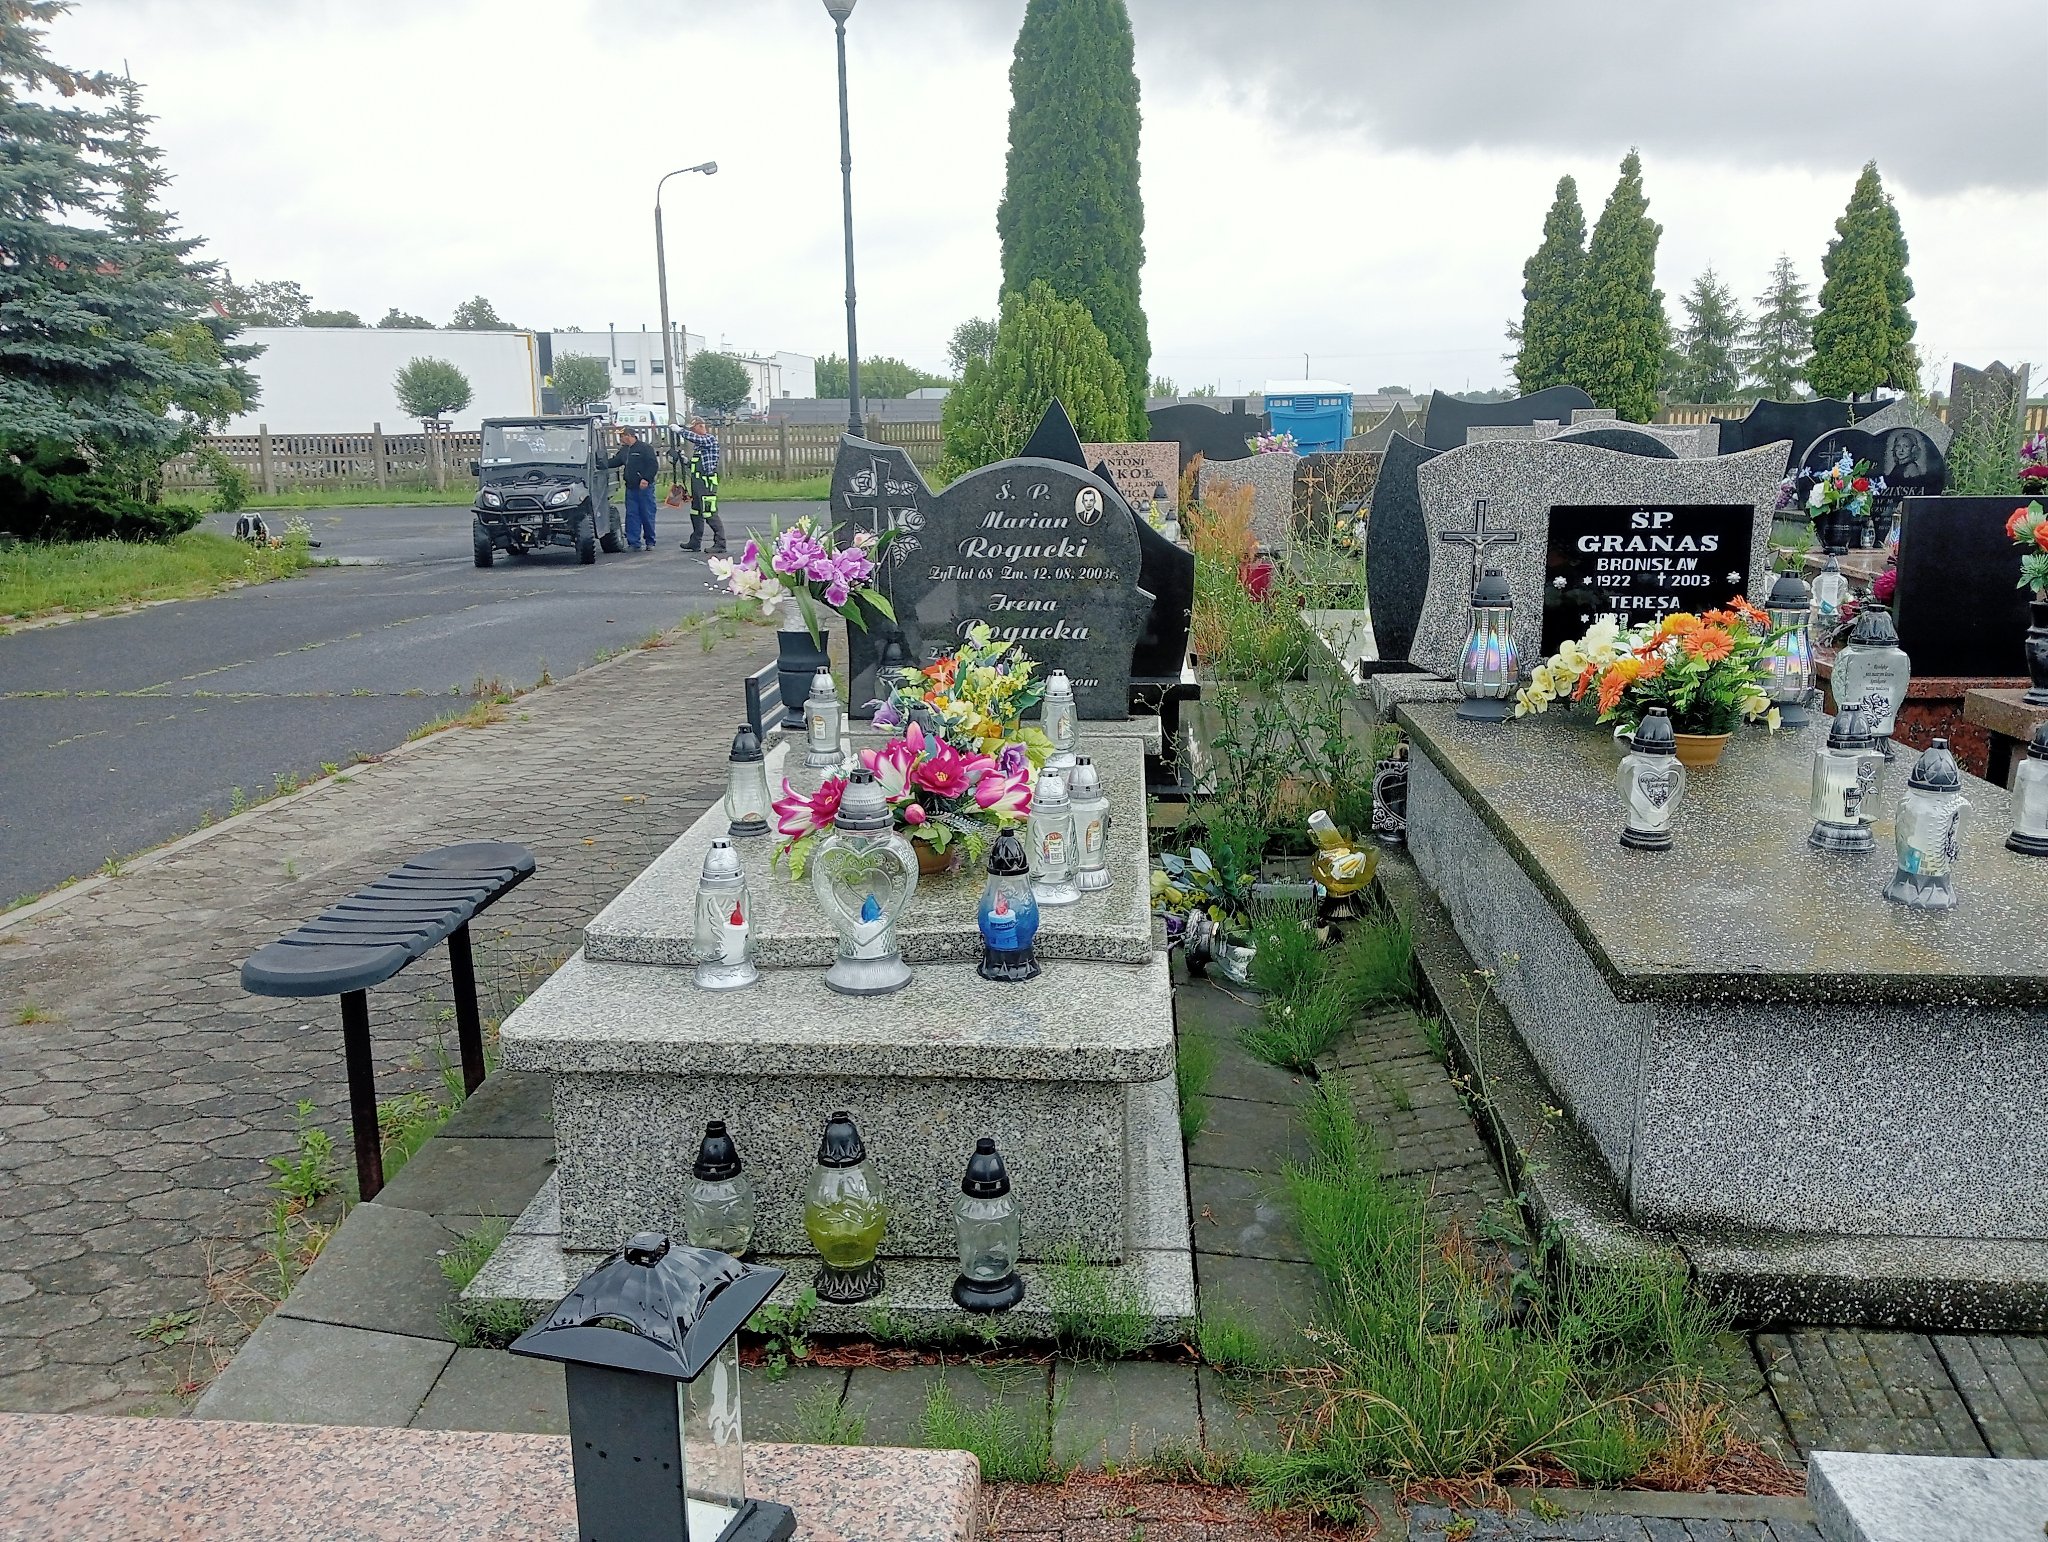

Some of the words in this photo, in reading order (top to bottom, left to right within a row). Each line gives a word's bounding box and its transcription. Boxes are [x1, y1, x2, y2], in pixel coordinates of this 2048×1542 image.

[1107, 458, 1145, 467] NTONI
[1026, 483, 1051, 501] P.
[975, 510, 1069, 530] Marian
[958, 535, 1089, 564] Rogucki
[1577, 534, 1719, 553] GRANAS
[1596, 557, 1699, 572] BRONISŁAW
[977, 567, 994, 580] 68
[1033, 568, 1051, 580] 12.
[1055, 567, 1075, 580] 08.
[1596, 574, 1632, 587] 1922
[1670, 574, 1711, 587] 2003
[988, 593, 1059, 613] Irena
[1608, 595, 1681, 609] TERESA
